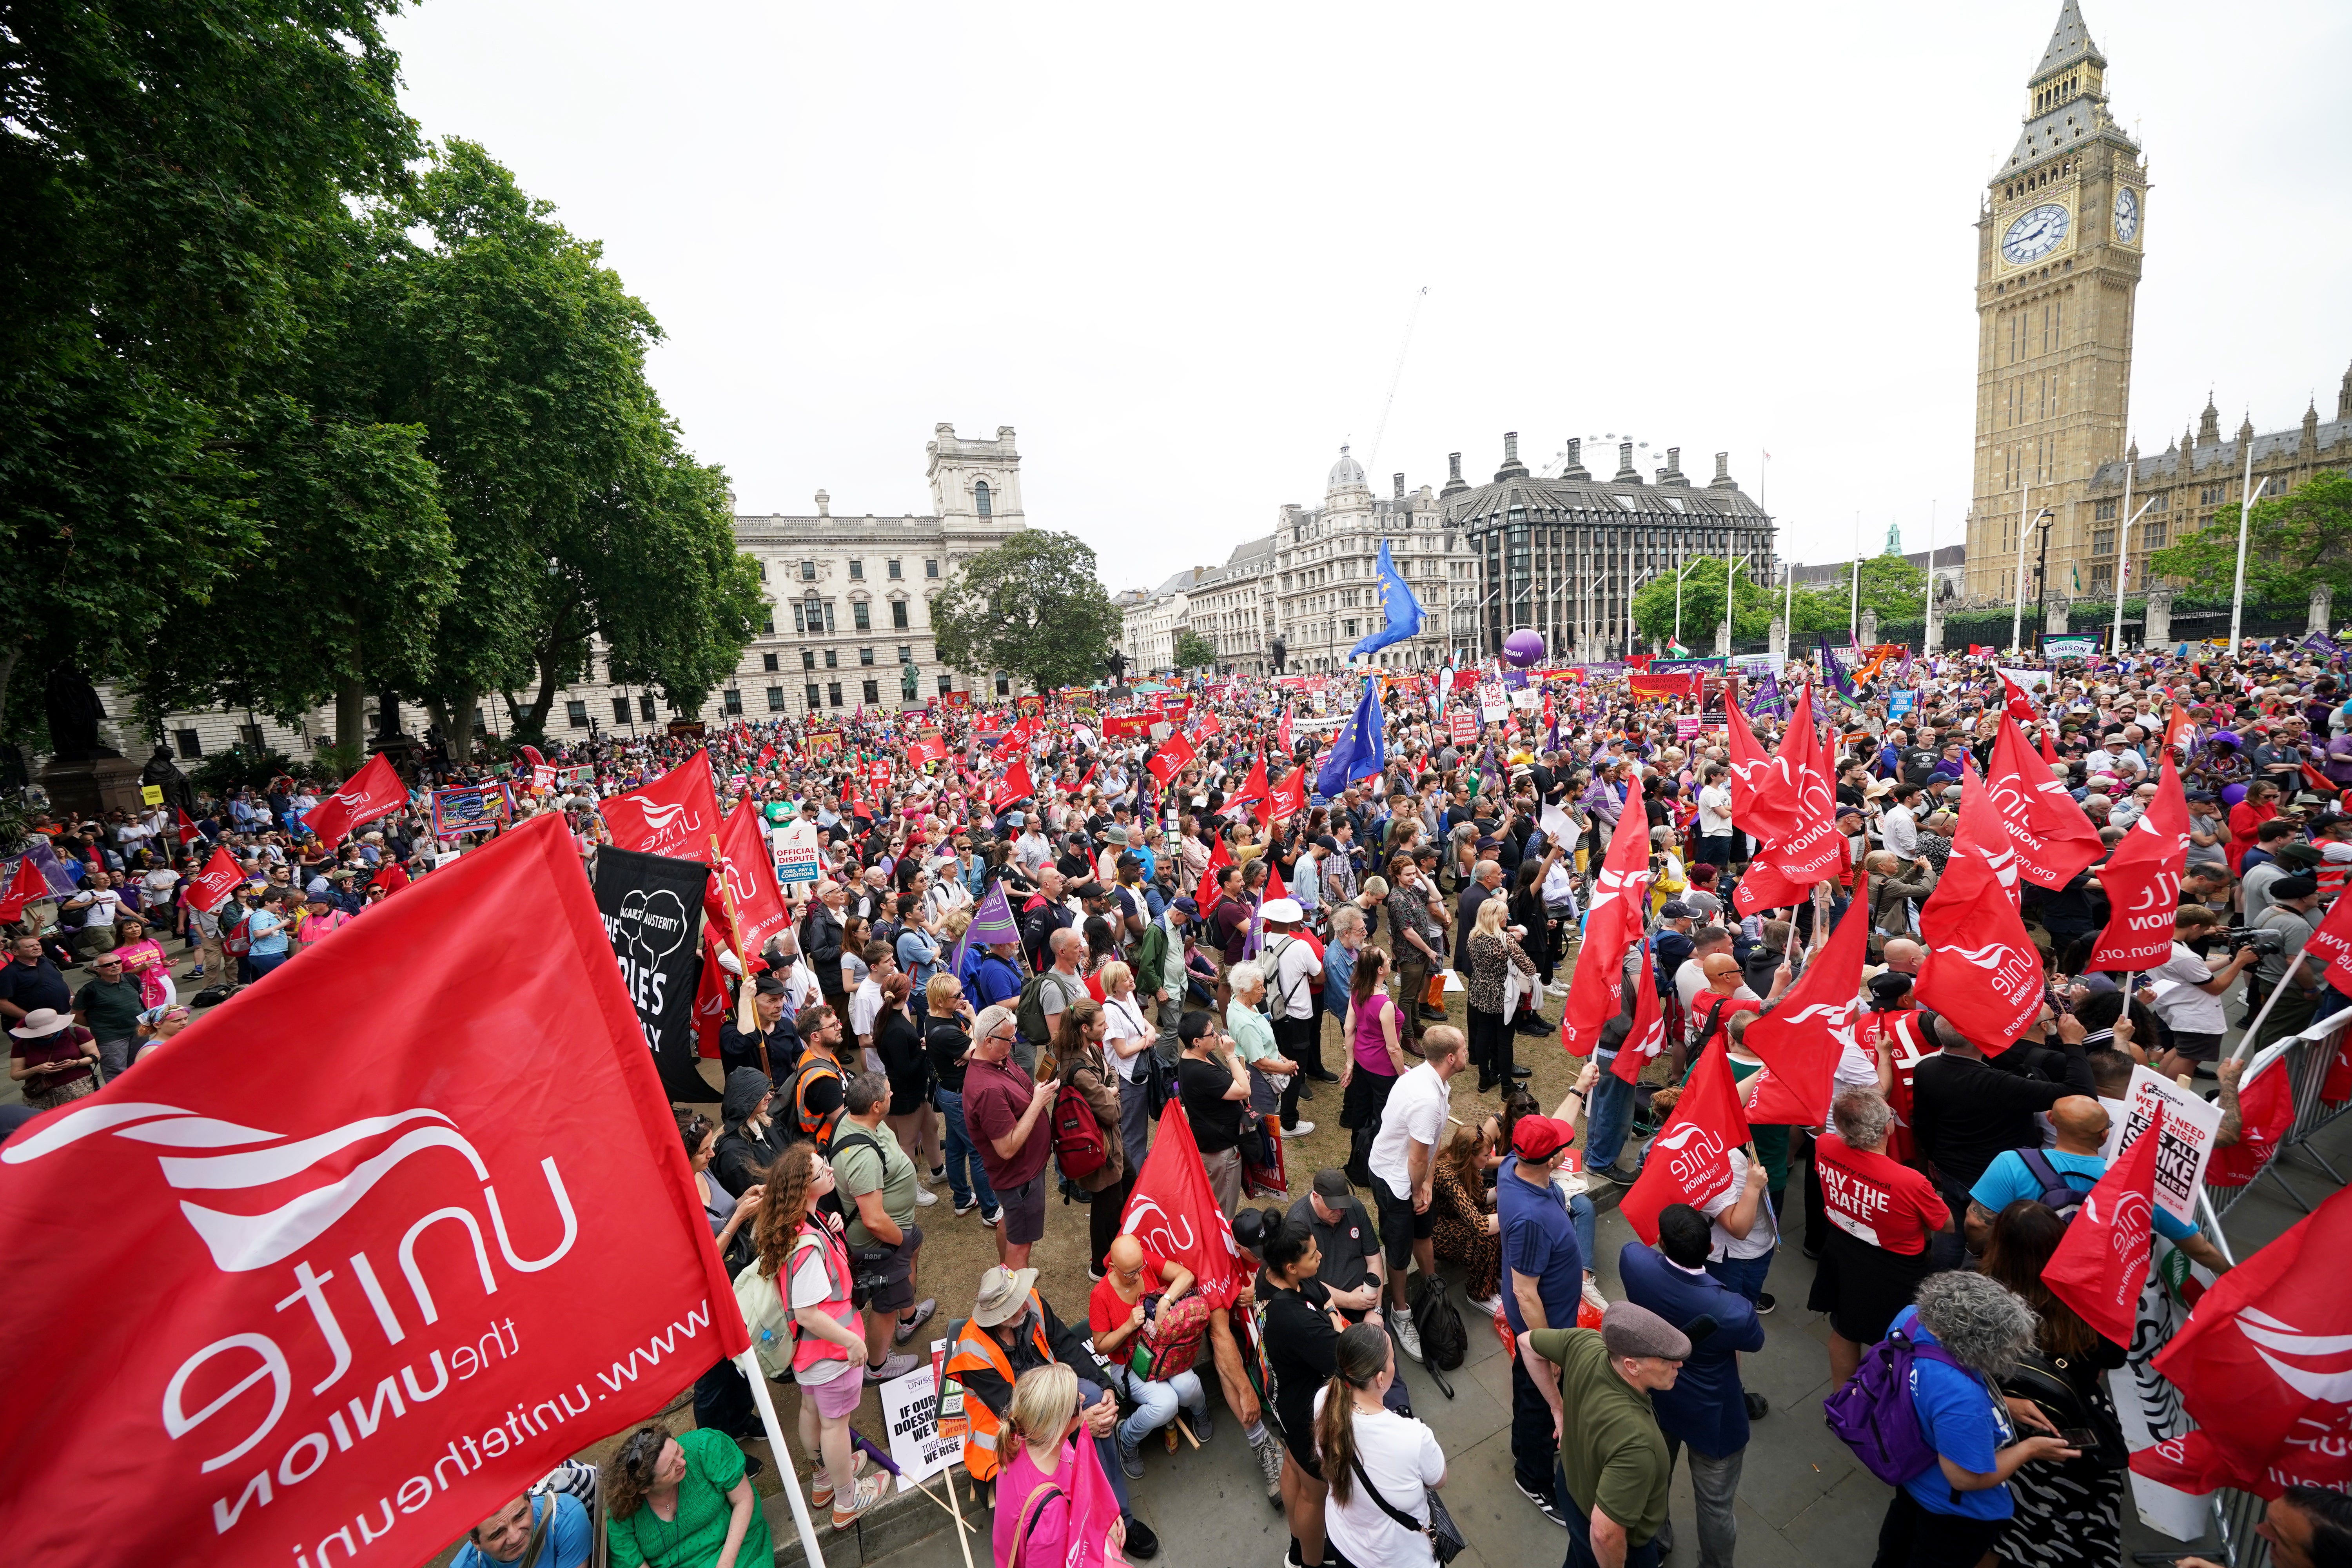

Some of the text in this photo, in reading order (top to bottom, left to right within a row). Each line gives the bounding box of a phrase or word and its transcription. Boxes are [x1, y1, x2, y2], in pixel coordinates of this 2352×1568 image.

[1503, 647, 1521, 656] USDAW
[1816, 647, 1855, 656] LBETH
[2309, 639, 2335, 653] UNISON
[1663, 664, 1686, 674] GREATER
[1485, 684, 1501, 693] EAT
[1486, 692, 1502, 700] THE
[1485, 699, 1506, 708] RICH
[479, 780, 499, 790] MAKE
[480, 786, 499, 795] THEM
[486, 792, 497, 801] PAY
[284, 809, 309, 819] NUSES
[776, 847, 816, 857] OFFICIAL
[779, 855, 815, 864] DISPUTE
[643, 913, 679, 932] AUSTERITY
[128, 949, 151, 960] ENOUGH
[2147, 1088, 2169, 1105] Party
[2152, 1083, 2184, 1107] Socialist
[2136, 1094, 2206, 1141] WE NEED
[2137, 1107, 2199, 1148] A RISE!
[2172, 1140, 2198, 1162] ALL
[1820, 1152, 1891, 1191] Coventry council
[1818, 1163, 1890, 1213] PAY THE
[1829, 1191, 1873, 1222] RATE
[908, 1375, 935, 1389] UNISO
[900, 1394, 936, 1419] IF OUR
[894, 1407, 935, 1437] DOESN'
[912, 1428, 931, 1443] WE
[946, 1423, 966, 1436] prote
[924, 1441, 960, 1465] WE RISE
